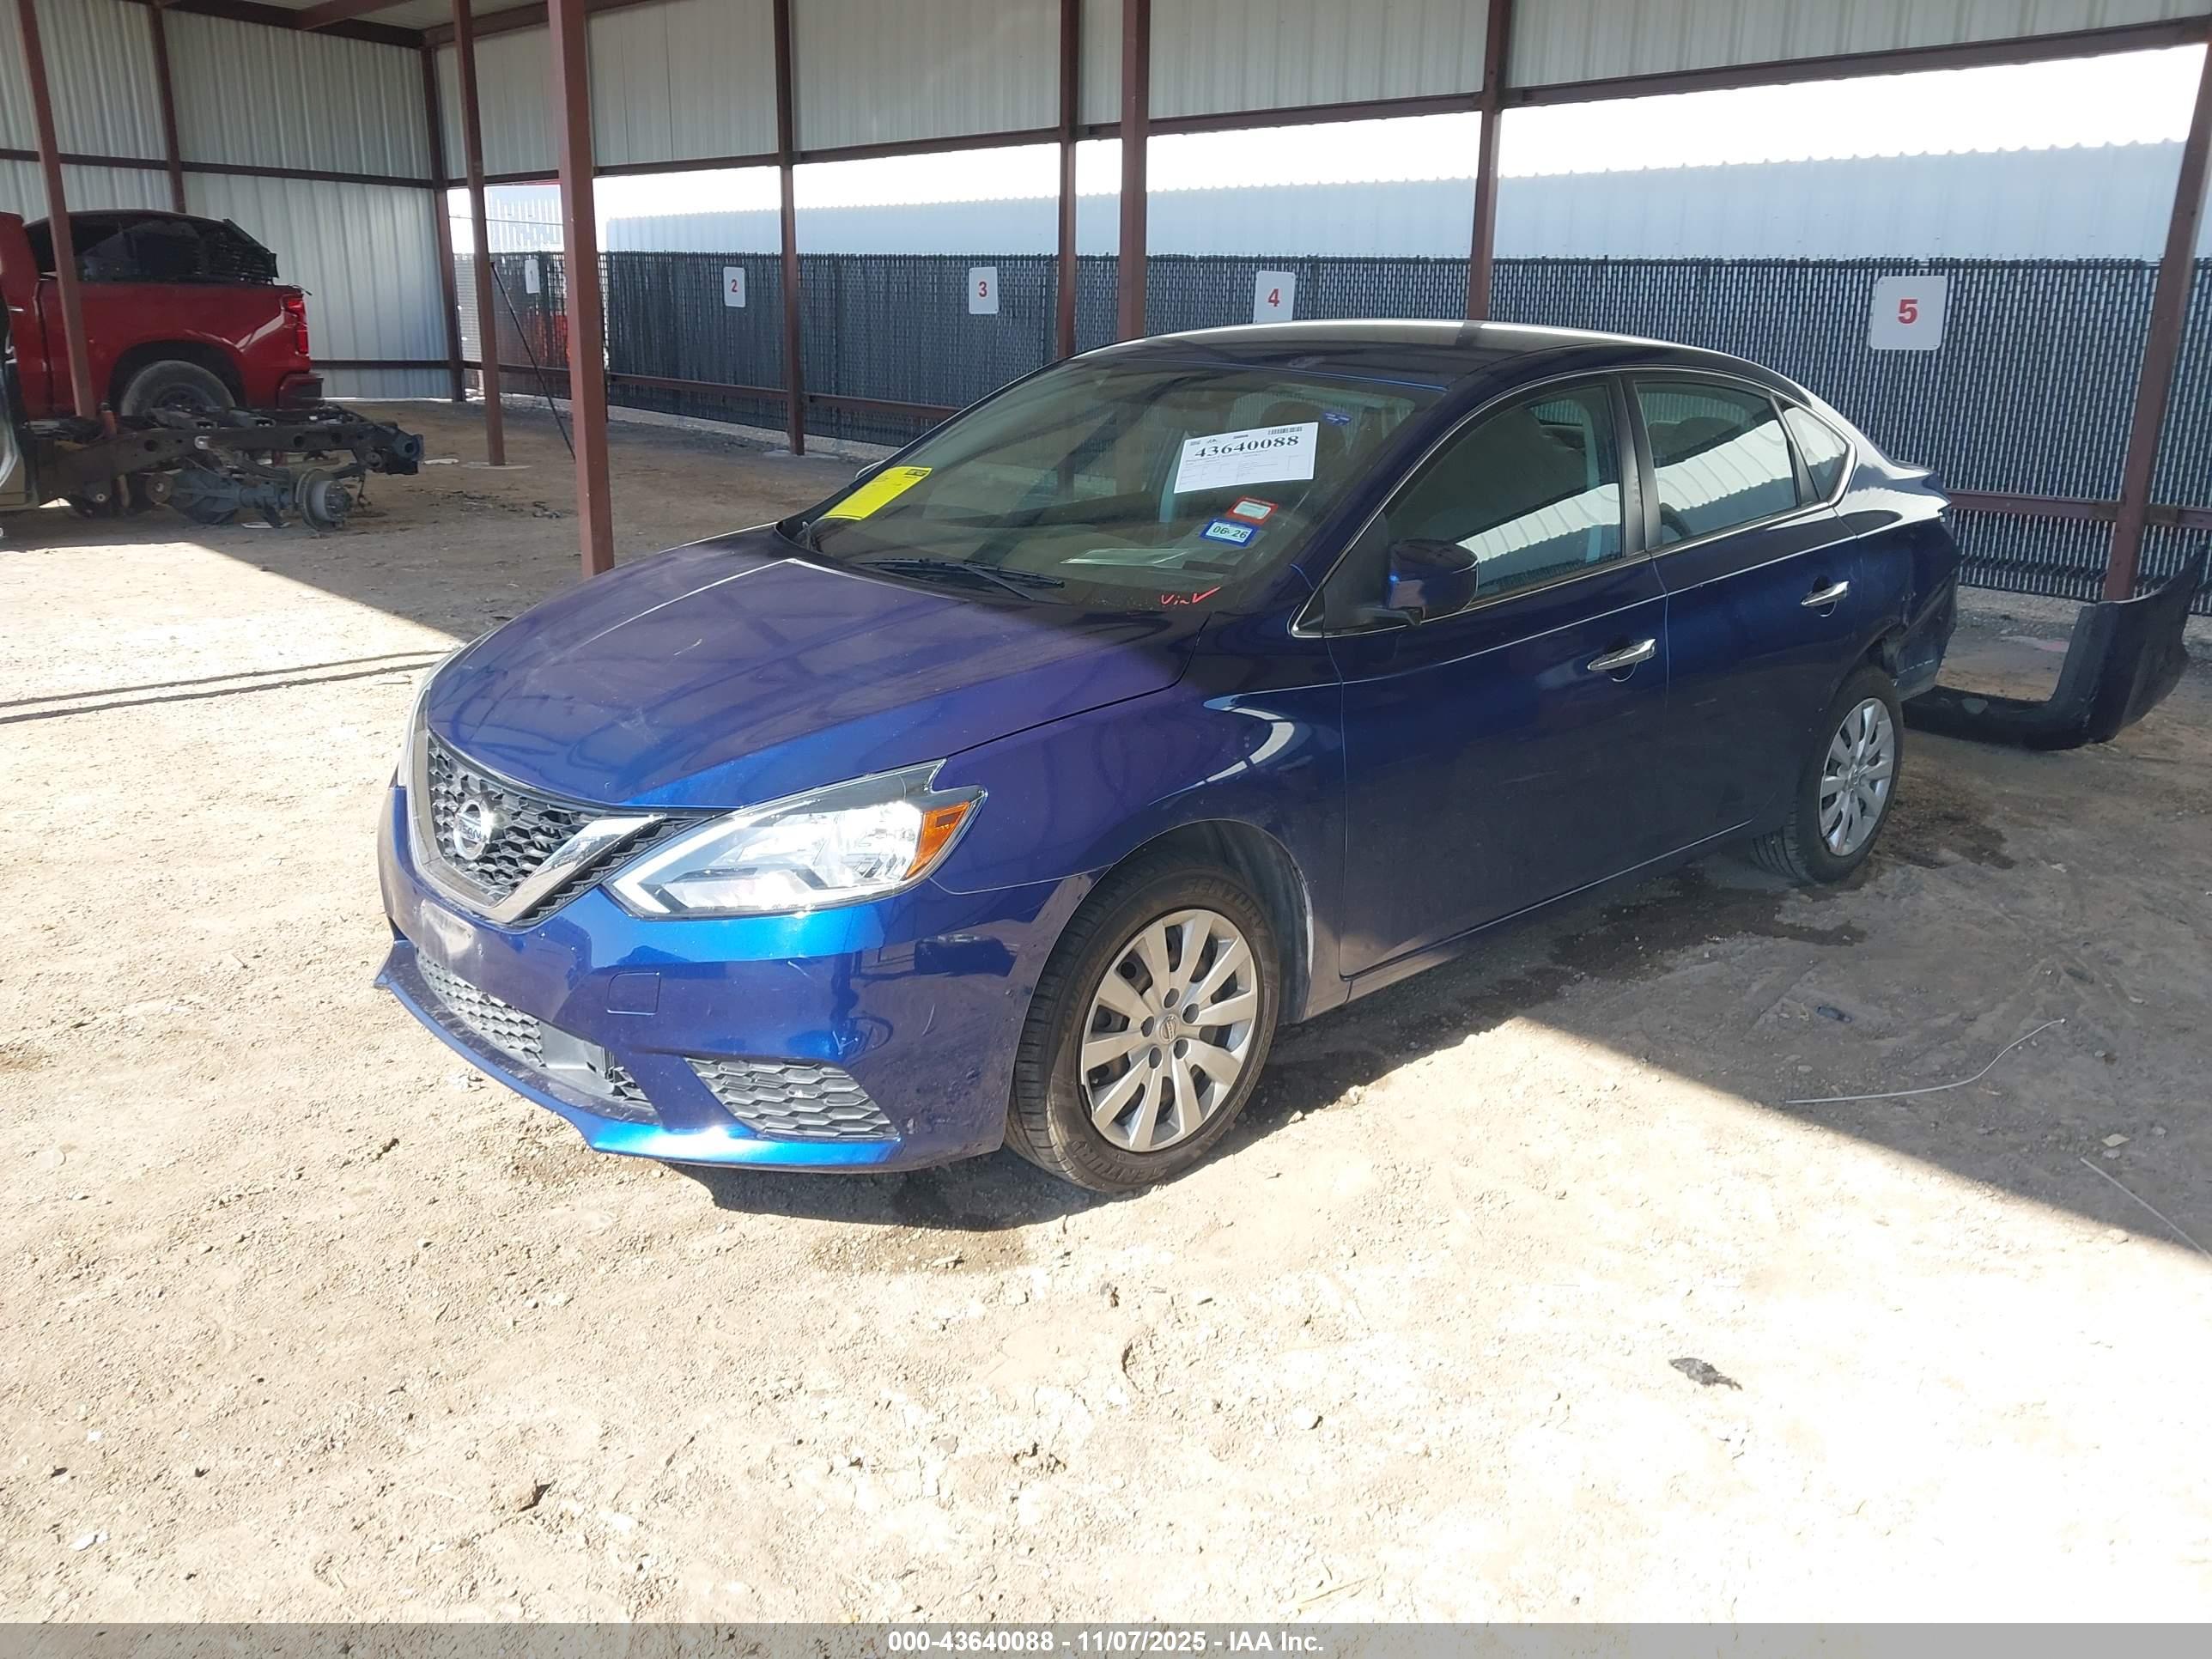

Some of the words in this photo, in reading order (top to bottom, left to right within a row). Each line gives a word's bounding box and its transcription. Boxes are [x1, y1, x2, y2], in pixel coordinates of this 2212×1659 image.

[731, 278, 738, 293] 2
[978, 281, 988, 298] 3
[1267, 288, 1280, 307] 4
[1898, 299, 1918, 324] 5
[1194, 435, 1299, 458] 43640088
